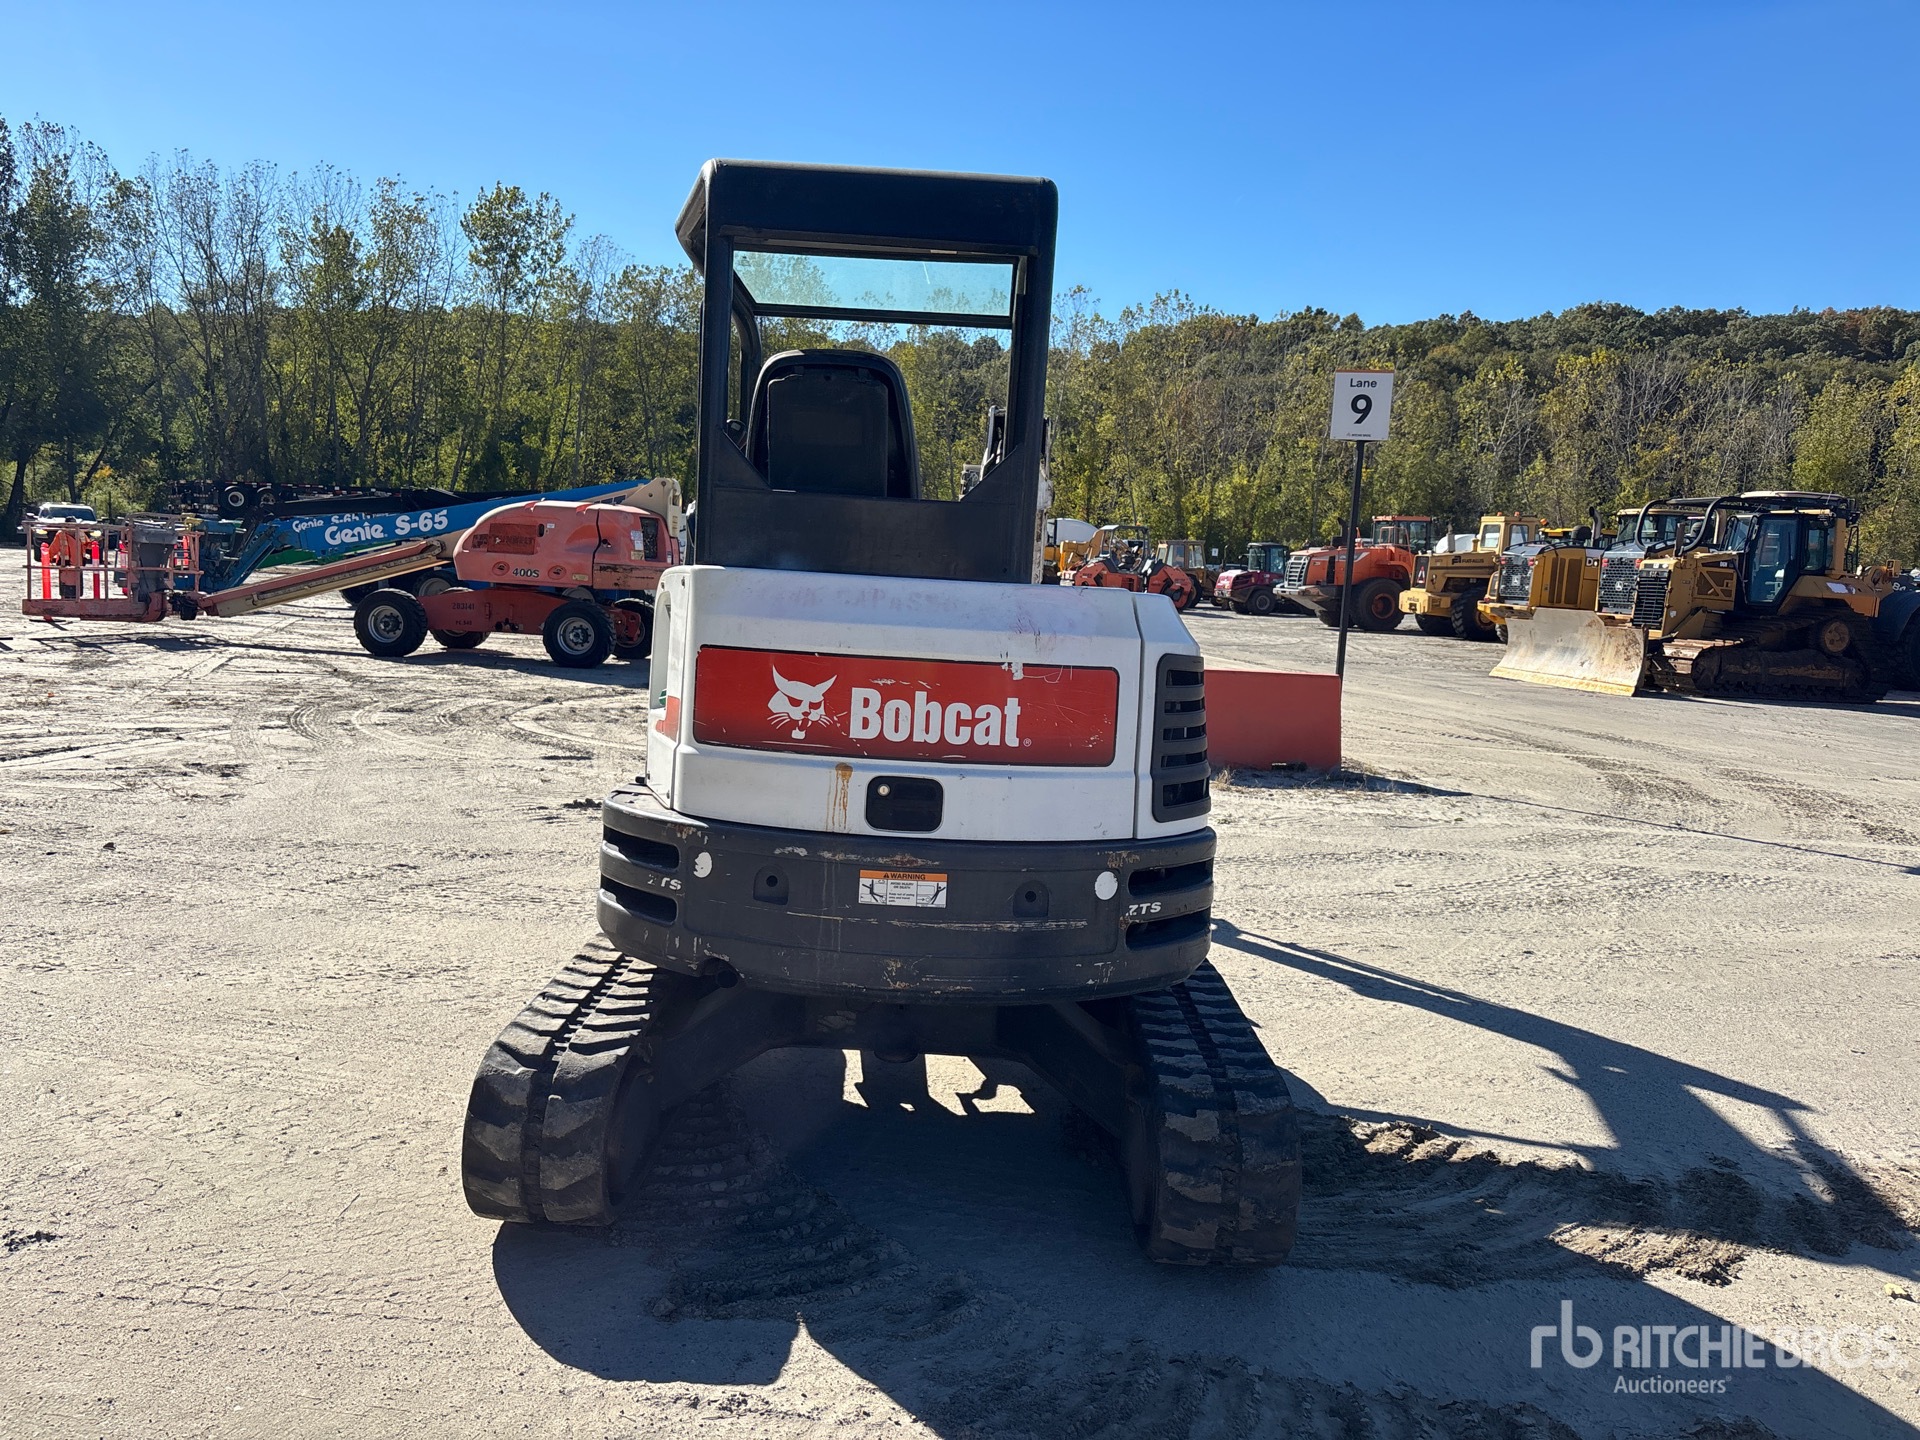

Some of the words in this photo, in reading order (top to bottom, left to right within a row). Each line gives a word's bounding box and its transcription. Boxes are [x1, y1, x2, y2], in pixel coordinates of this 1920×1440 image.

[1350, 378, 1377, 388] Lane
[1351, 394, 1373, 425] 9
[324, 521, 384, 546] Genie
[395, 509, 449, 536] S-65
[512, 568, 540, 578] 400S
[849, 687, 1021, 748] Bobcat
[890, 873, 926, 881] WARNING
[1126, 902, 1161, 916] ZTS
